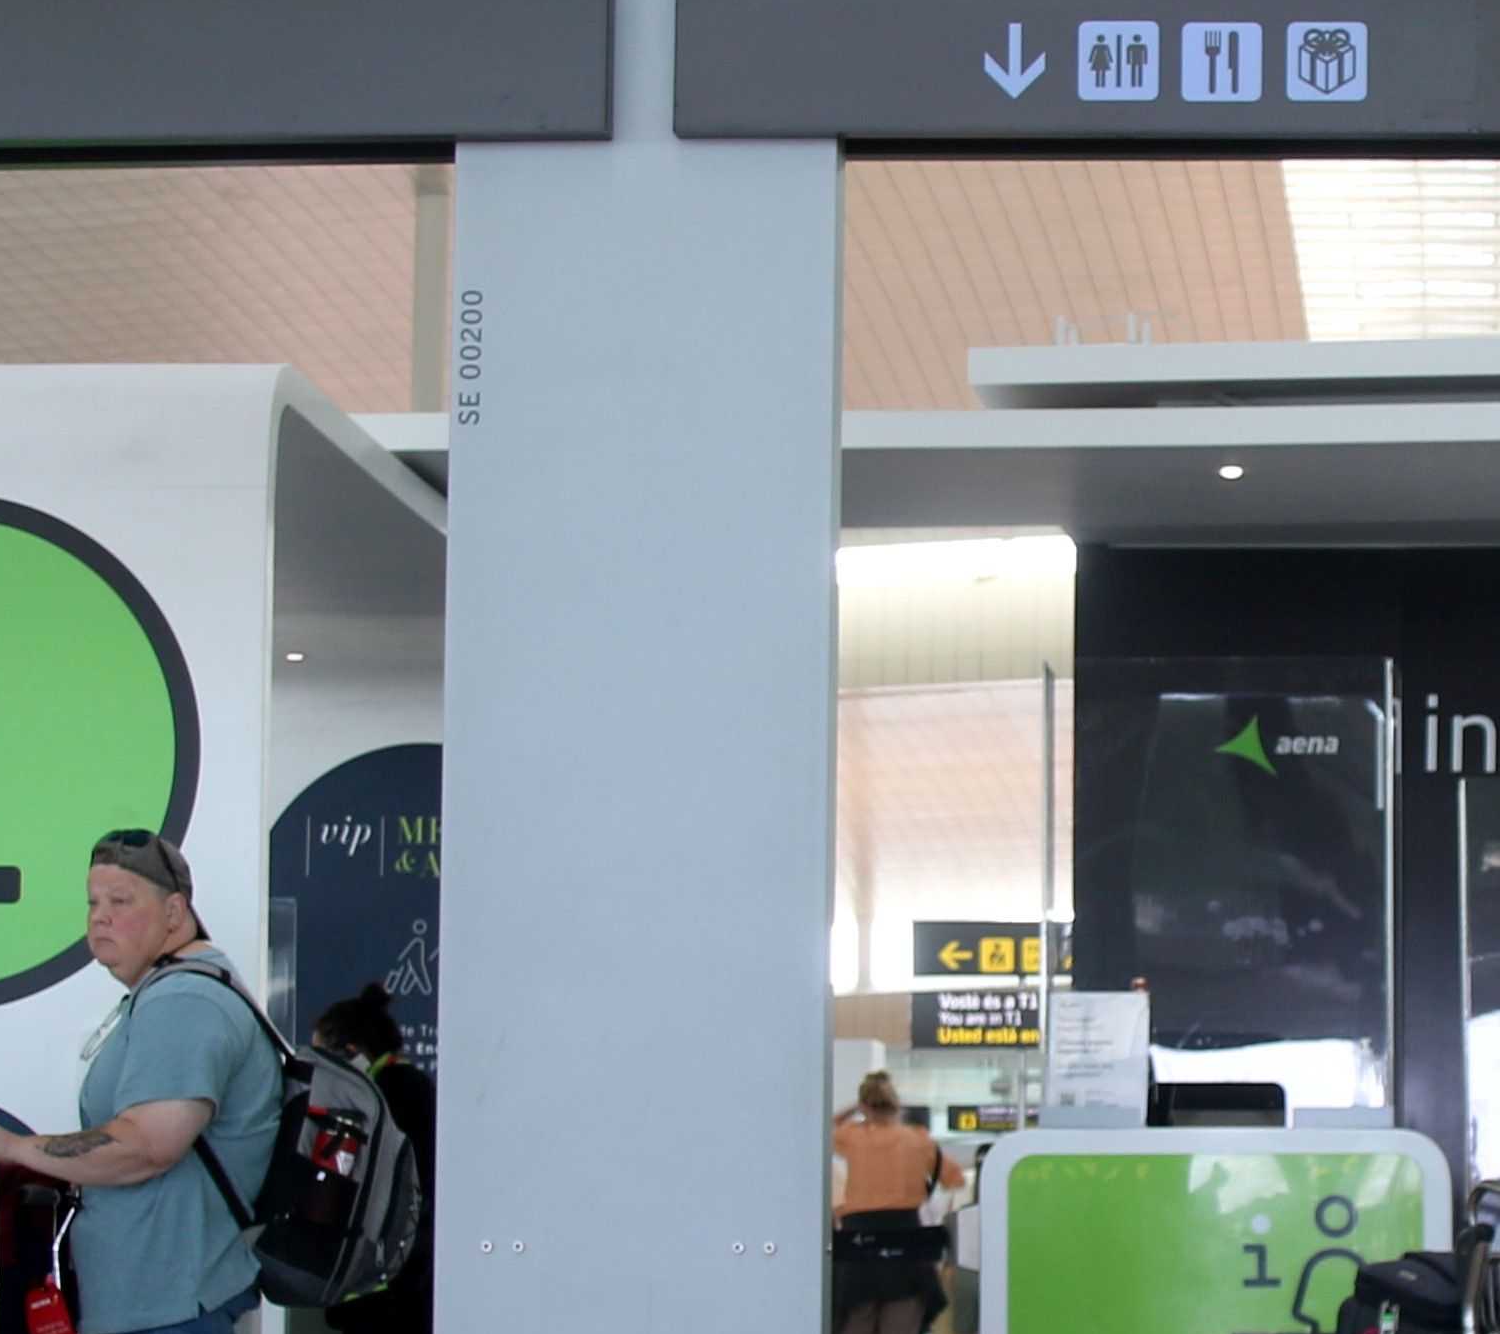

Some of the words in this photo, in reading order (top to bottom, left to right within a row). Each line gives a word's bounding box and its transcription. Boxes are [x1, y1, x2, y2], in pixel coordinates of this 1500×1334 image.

[459, 290, 483, 380] 00200
[458, 392, 481, 425] SE
[1274, 735, 1340, 756] aena
[320, 815, 372, 857] vip
